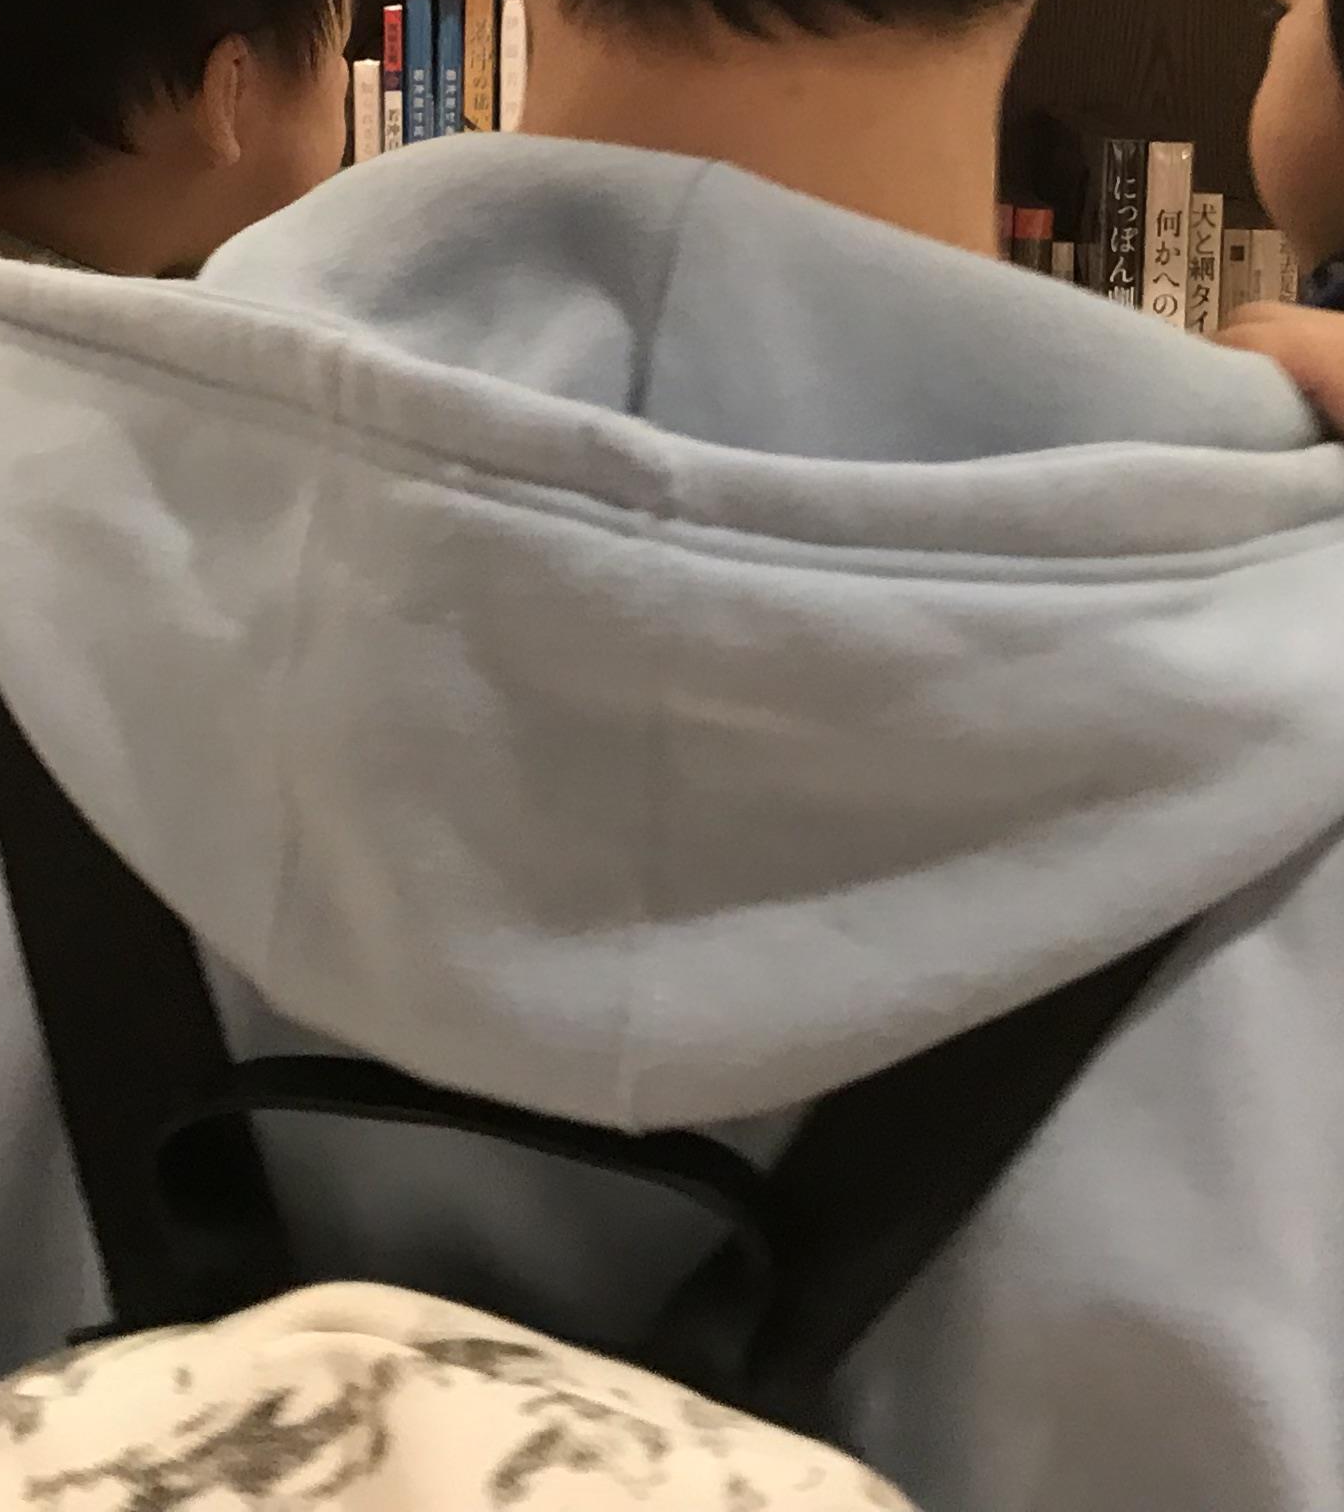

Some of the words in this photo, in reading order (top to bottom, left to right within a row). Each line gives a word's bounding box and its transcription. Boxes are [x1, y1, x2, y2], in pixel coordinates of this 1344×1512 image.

[1152, 209, 1183, 317] 何かへの
[1190, 203, 1216, 333] 犬と網タイ
